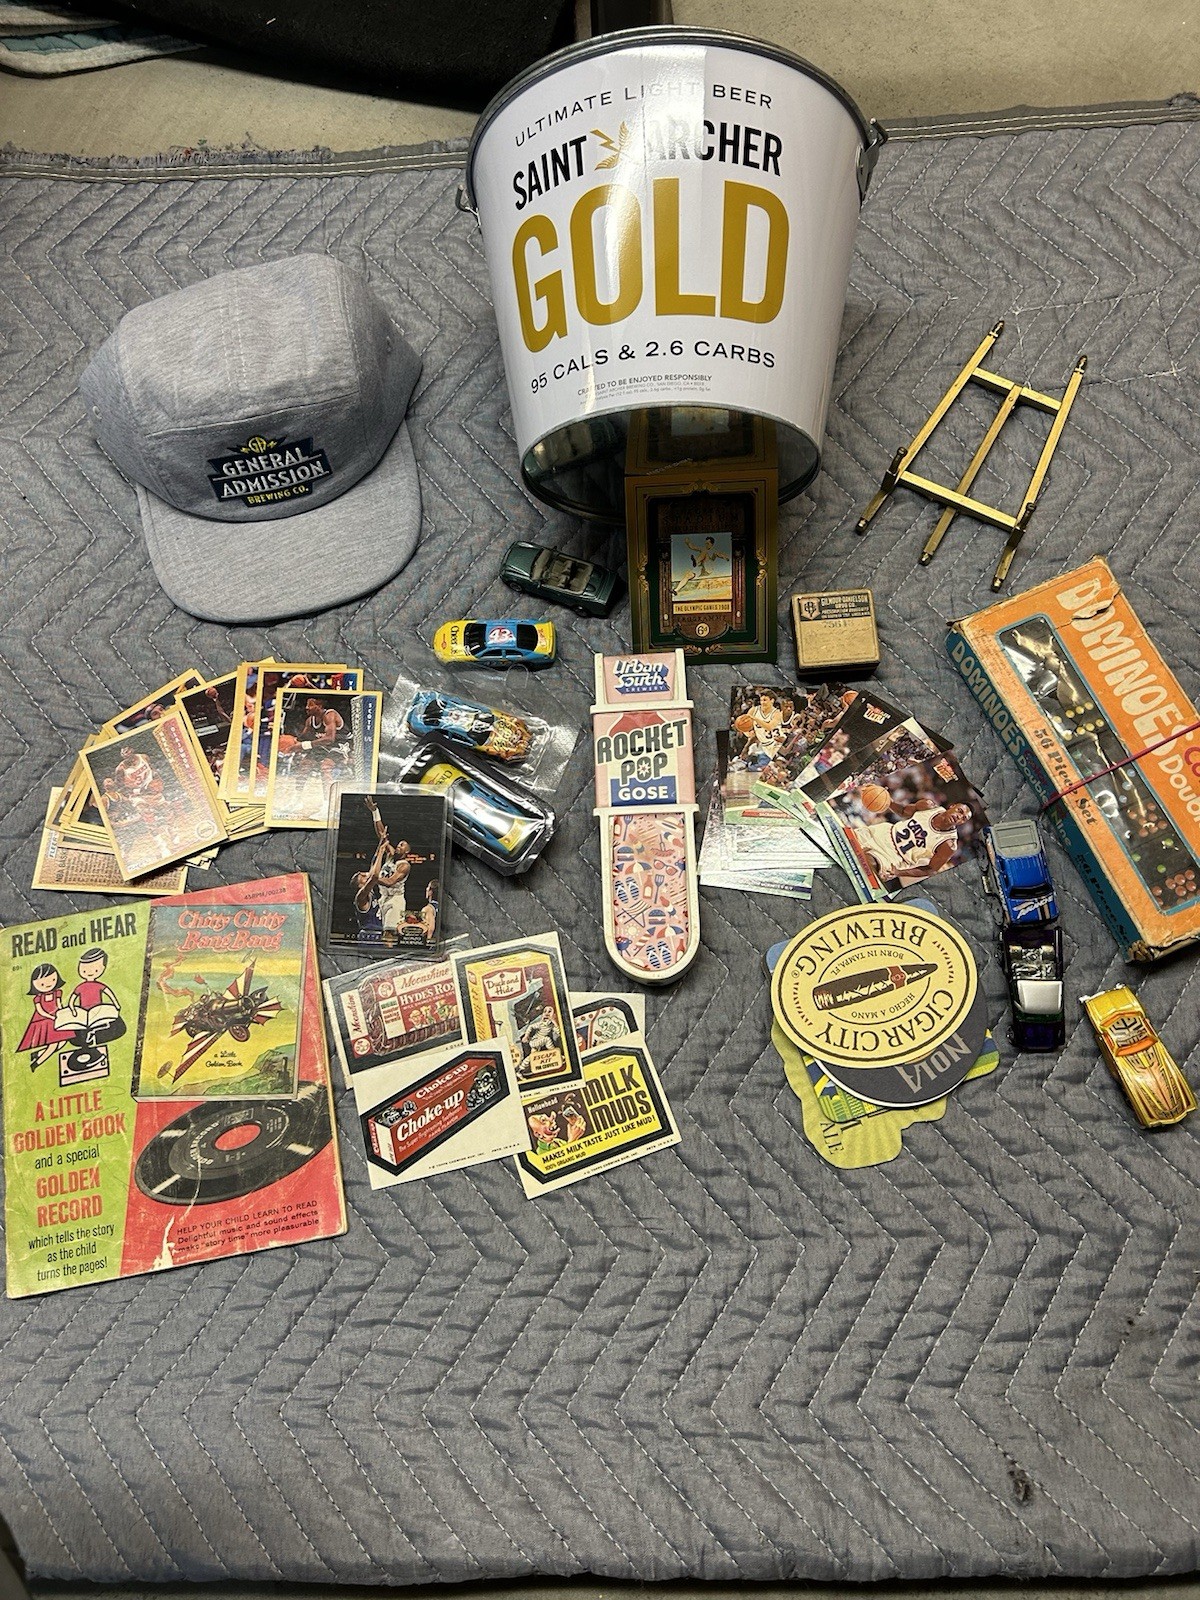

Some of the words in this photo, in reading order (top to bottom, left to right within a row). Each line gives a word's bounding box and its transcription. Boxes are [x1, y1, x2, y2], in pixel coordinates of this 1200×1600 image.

[515, 91, 612, 147] ULTIMATE
[624, 81, 701, 101] LIGHT
[713, 84, 772, 109] BEER
[513, 135, 587, 211] SAINT
[646, 116, 783, 177] ARCHER
[511, 176, 790, 353] GOLD
[531, 373, 548, 394] 95
[553, 349, 609, 380] CALS
[618, 344, 636, 360] &
[645, 340, 684, 357] 2.6
[694, 341, 775, 368] CARBS
[629, 375, 663, 384] ENJOYED
[664, 374, 713, 382] RESPONSIBLY
[222, 447, 309, 477] GENERAL
[223, 460, 325, 497] ADMISSION
[247, 489, 291, 505] BREWING
[293, 485, 309, 495] CO.
[613, 658, 663, 675] Urban
[615, 672, 665, 689] South
[1056, 578, 1194, 757] DOMINOES
[951, 640, 1026, 758] DOMINOES
[597, 720, 688, 765] ROCKET
[621, 752, 668, 786] POP
[1034, 728, 1053, 749] 56
[1047, 752, 1079, 797] Piece
[1075, 797, 1098, 826] Set
[618, 785, 669, 801] GOSE
[1017, 756, 1049, 805] Double
[1051, 811, 1072, 847] Nine
[895, 829, 915, 855] 21
[907, 819, 928, 849] CAVS
[12, 927, 58, 958] READ
[61, 927, 87, 949] and
[90, 912, 137, 943] HEAR
[178, 909, 232, 932] Chitty
[233, 909, 288, 932] Chitty
[177, 930, 234, 953] Bang
[227, 929, 284, 953] Bang
[799, 917, 928, 977] BREWING
[880, 949, 904, 959] BORN
[400, 966, 450, 990] Moonshine
[485, 978, 505, 990] Duck
[505, 976, 519, 985] and
[495, 986, 513, 996] Hide
[347, 994, 362, 1033] Moonshine
[852, 1011, 878, 1019] MANO
[881, 989, 954, 1048] CIGAR
[889, 992, 915, 1013] HECHO
[815, 1022, 880, 1052] CITY
[205, 1060, 226, 1068] Golden
[226, 1059, 243, 1067] Book
[533, 1052, 556, 1061] ESCAPE
[894, 1032, 972, 1094] NOLA
[581, 1064, 640, 1107] MILK
[35, 1101, 45, 1122] A
[50, 1090, 103, 1120] LITTLE
[396, 1089, 465, 1141] Choke-up
[590, 1090, 652, 1134] MUDS
[14, 1122, 77, 1153] GOLDEN
[82, 1113, 127, 1142] BOOK
[541, 1150, 565, 1164] MAKES
[566, 1142, 584, 1154] MILK
[583, 1135, 603, 1148] TASTE
[604, 1128, 621, 1141] JUST
[622, 1123, 637, 1133] LIKE
[636, 1114, 656, 1128] MUD!
[820, 1121, 844, 1155] ALE
[35, 1152, 53, 1169] and
[56, 1155, 64, 1165] a
[66, 1144, 100, 1166] special
[556, 1155, 575, 1167] ORGANIC
[575, 1151, 586, 1160] MUD
[36, 1166, 100, 1199] GOLDEN
[37, 1195, 103, 1228] RECORD
[177, 1226, 197, 1235] HELP
[200, 1220, 222, 1230] YOUR
[225, 1214, 250, 1225] CHILD
[253, 1209, 280, 1220] LEARN
[283, 1204, 293, 1213] TO
[296, 1200, 318, 1210] READ
[178, 1231, 216, 1245] Delightful
[219, 1226, 243, 1236] music
[246, 1221, 261, 1230] and
[264, 1216, 288, 1227] sound
[291, 1209, 319, 1220] effects
[28, 1234, 54, 1250] which
[55, 1230, 74, 1245] tells
[76, 1227, 91, 1242] the
[92, 1222, 115, 1241] story
[251, 1229, 271, 1238] more
[273, 1219, 320, 1235] pleasurable
[47, 1251, 58, 1263] as
[59, 1246, 74, 1260] the
[75, 1241, 97, 1257] child
[37, 1267, 61, 1282] turns
[63, 1263, 77, 1277] the
[79, 1256, 108, 1278] pages!
